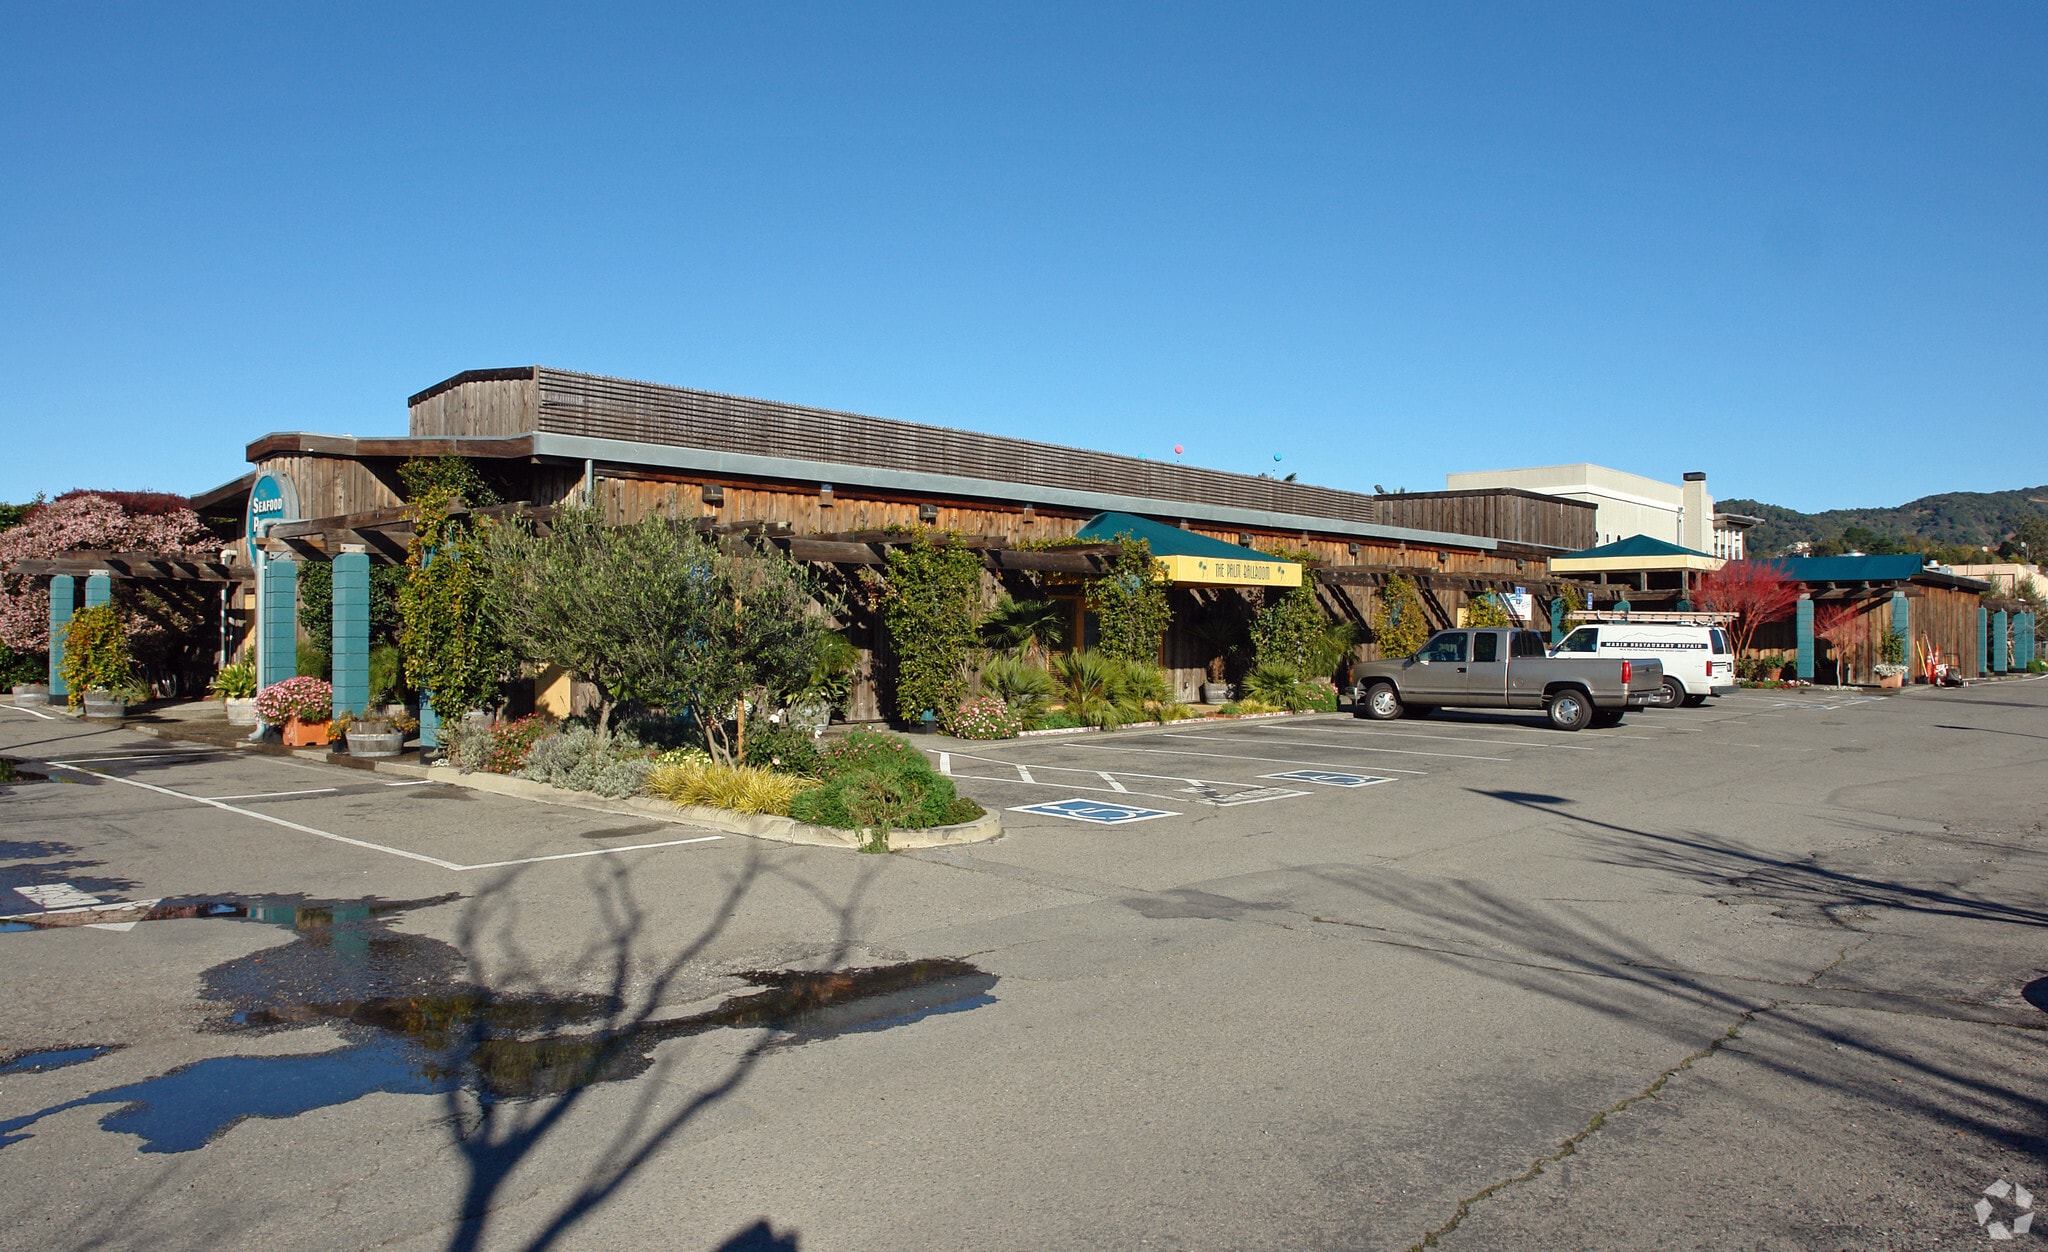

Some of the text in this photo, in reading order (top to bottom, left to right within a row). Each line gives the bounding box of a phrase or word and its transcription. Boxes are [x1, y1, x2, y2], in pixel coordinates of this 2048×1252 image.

[253, 497, 283, 514] SEAFOOD
[1215, 563, 1270, 580] THE PALM BALLROOM
